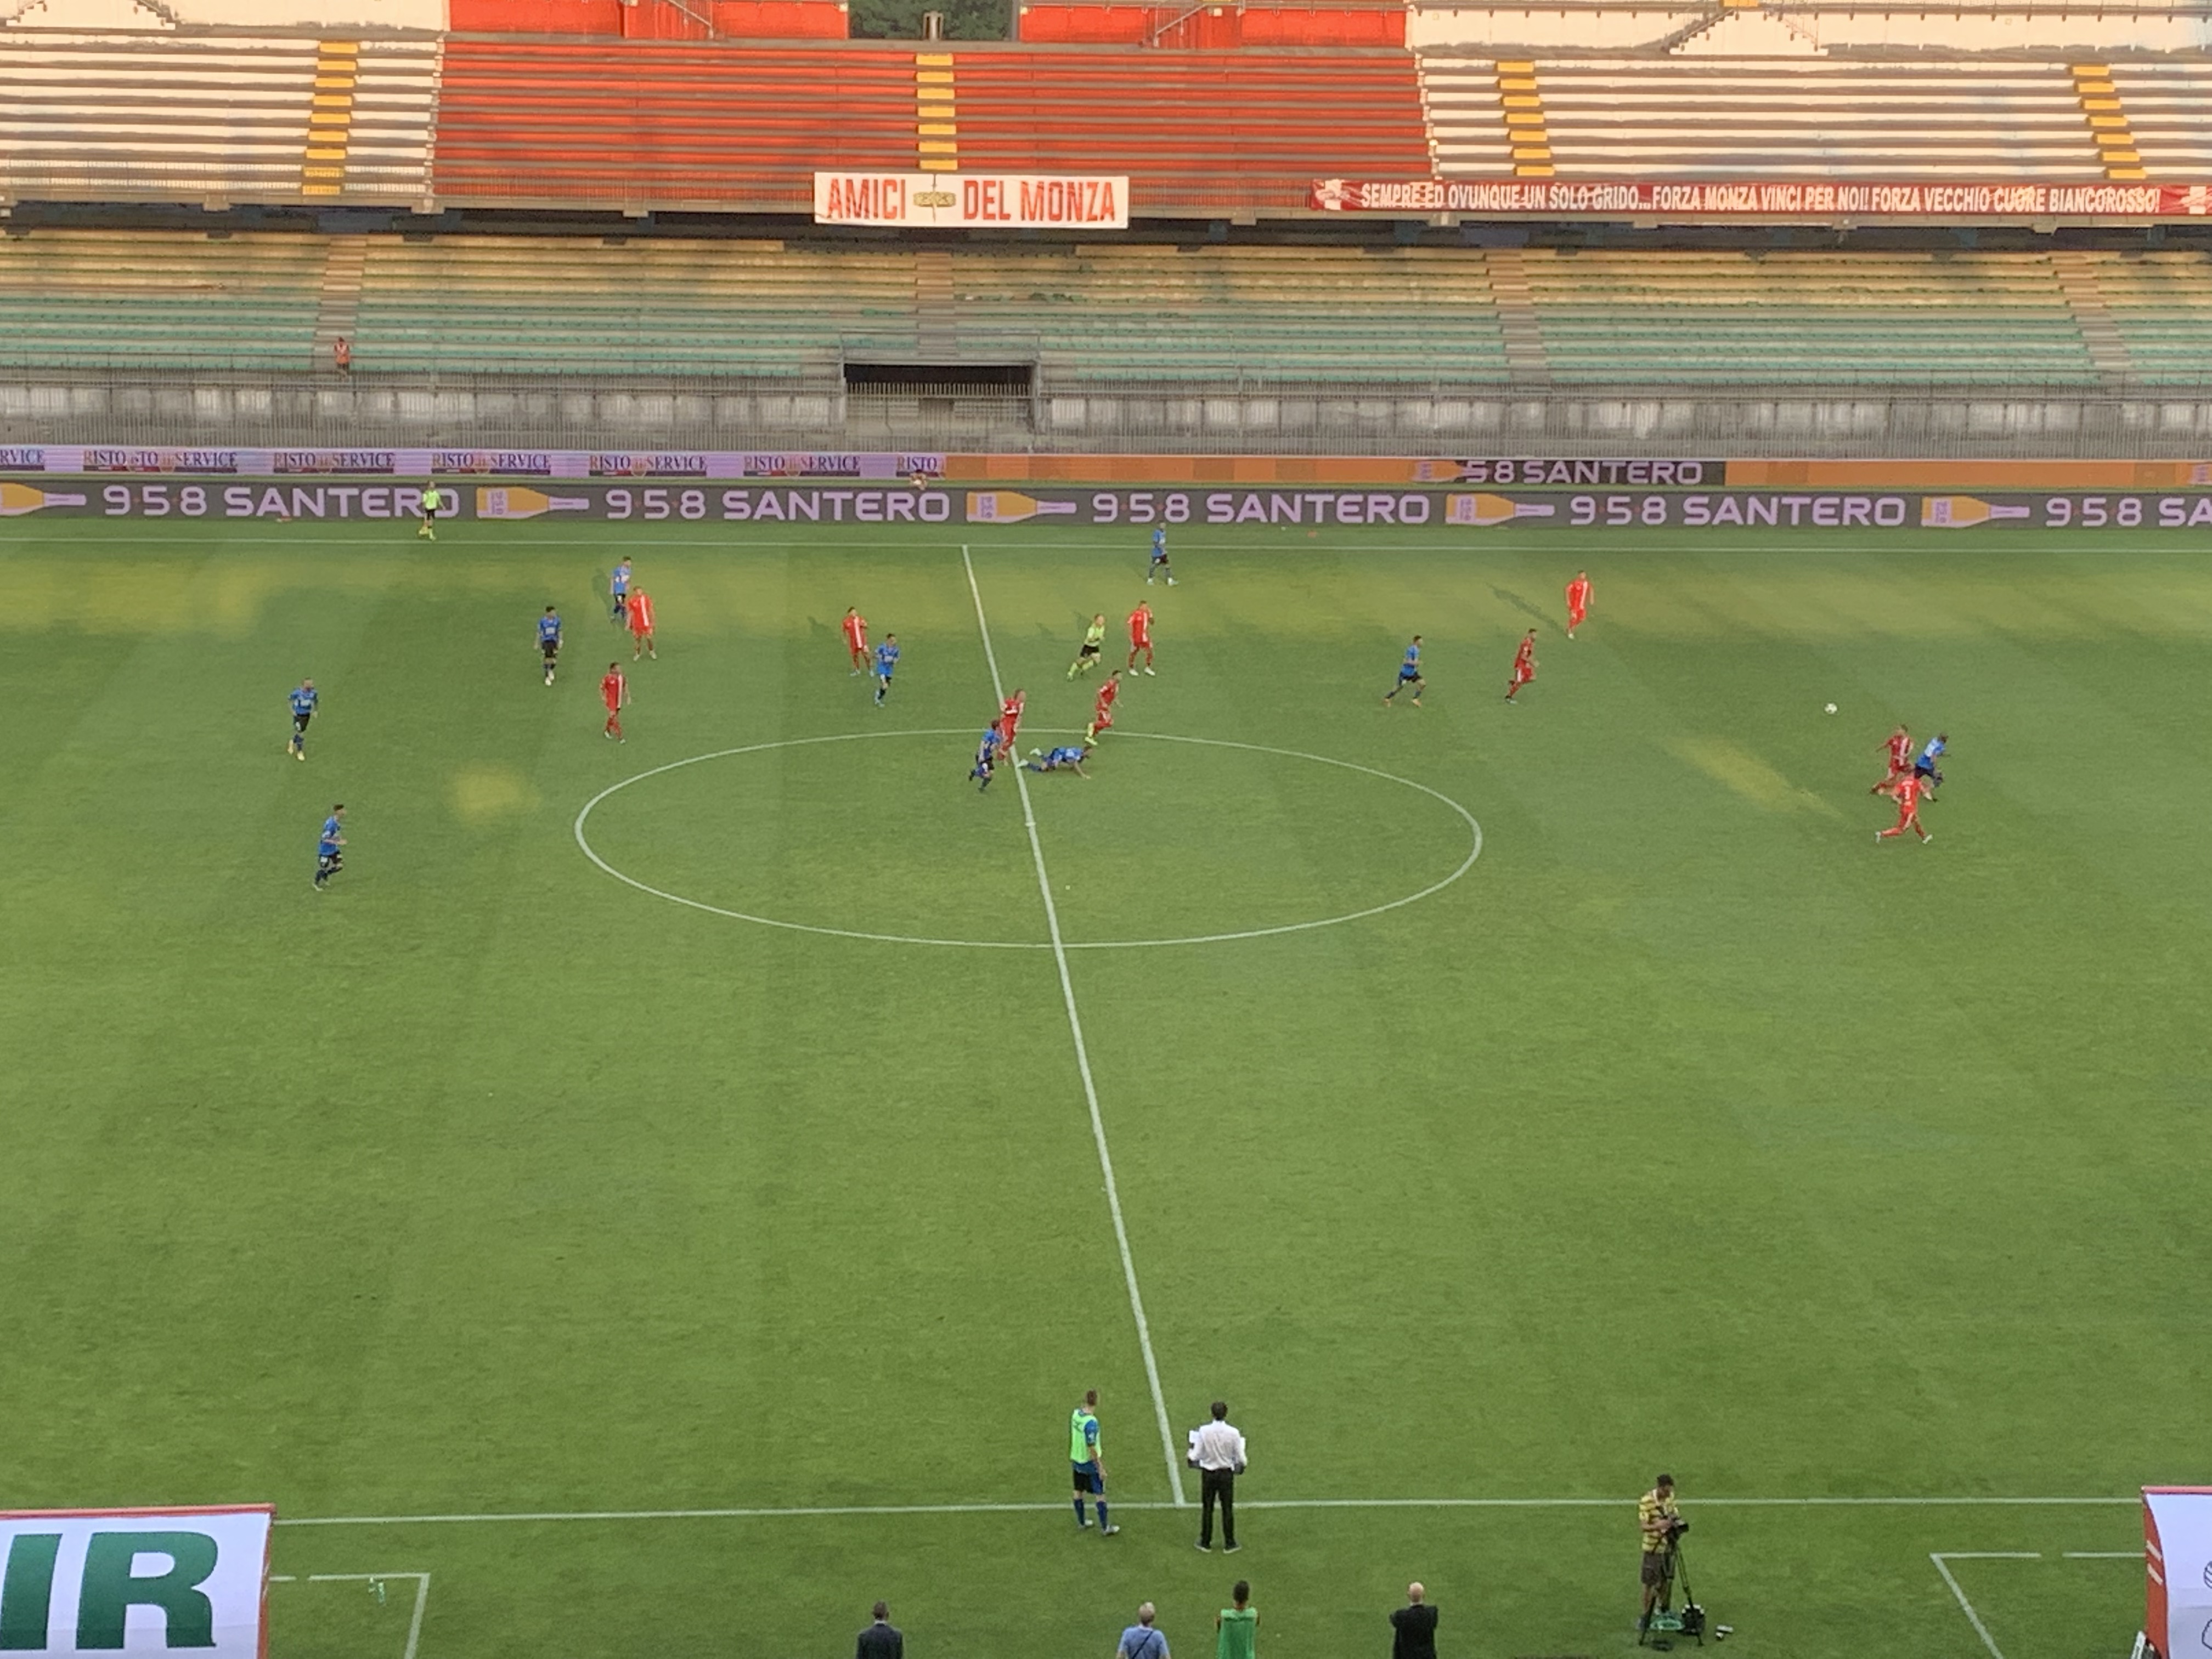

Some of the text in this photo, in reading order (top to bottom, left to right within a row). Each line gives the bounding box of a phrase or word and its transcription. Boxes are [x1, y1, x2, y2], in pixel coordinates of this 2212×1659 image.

[828, 179, 1115, 221] AMICI DEL MONZA
[1362, 183, 1420, 208] SEMPRE
[1425, 184, 1444, 208] ED
[1448, 184, 1520, 210] OVUNQUE
[1525, 185, 1545, 210] UN
[1549, 185, 1588, 210] SOLO
[1652, 185, 1701, 210] FORZA
[1705, 186, 1757, 211] MONZA
[1760, 186, 1801, 211] VINCI
[1805, 187, 1834, 211] PER
[1872, 187, 1920, 211] FORZA
[1925, 187, 1990, 212] VECCHIO
[1994, 187, 2046, 212] CUORE
[2049, 188, 2160, 213] BIANCOROSSO!
[83, 451, 127, 465] RISTO
[174, 452, 238, 467] SERVICE
[274, 452, 396, 467] RISTO SERVICE
[432, 453, 551, 468] RISTO SERVICE
[589, 455, 707, 470] RISTO SERVICE
[744, 456, 860, 471] RISTO SERVICE
[896, 456, 937, 471] RISTO
[1523, 461, 1702, 484] SANTERO
[224, 488, 459, 517] SANTERO
[723, 491, 950, 521] SANTERO
[1207, 494, 1430, 523] SANTERO
[1683, 497, 1906, 526] SANTERO
[2159, 498, 2212, 526] SA
[0, 1532, 218, 1650] IR
